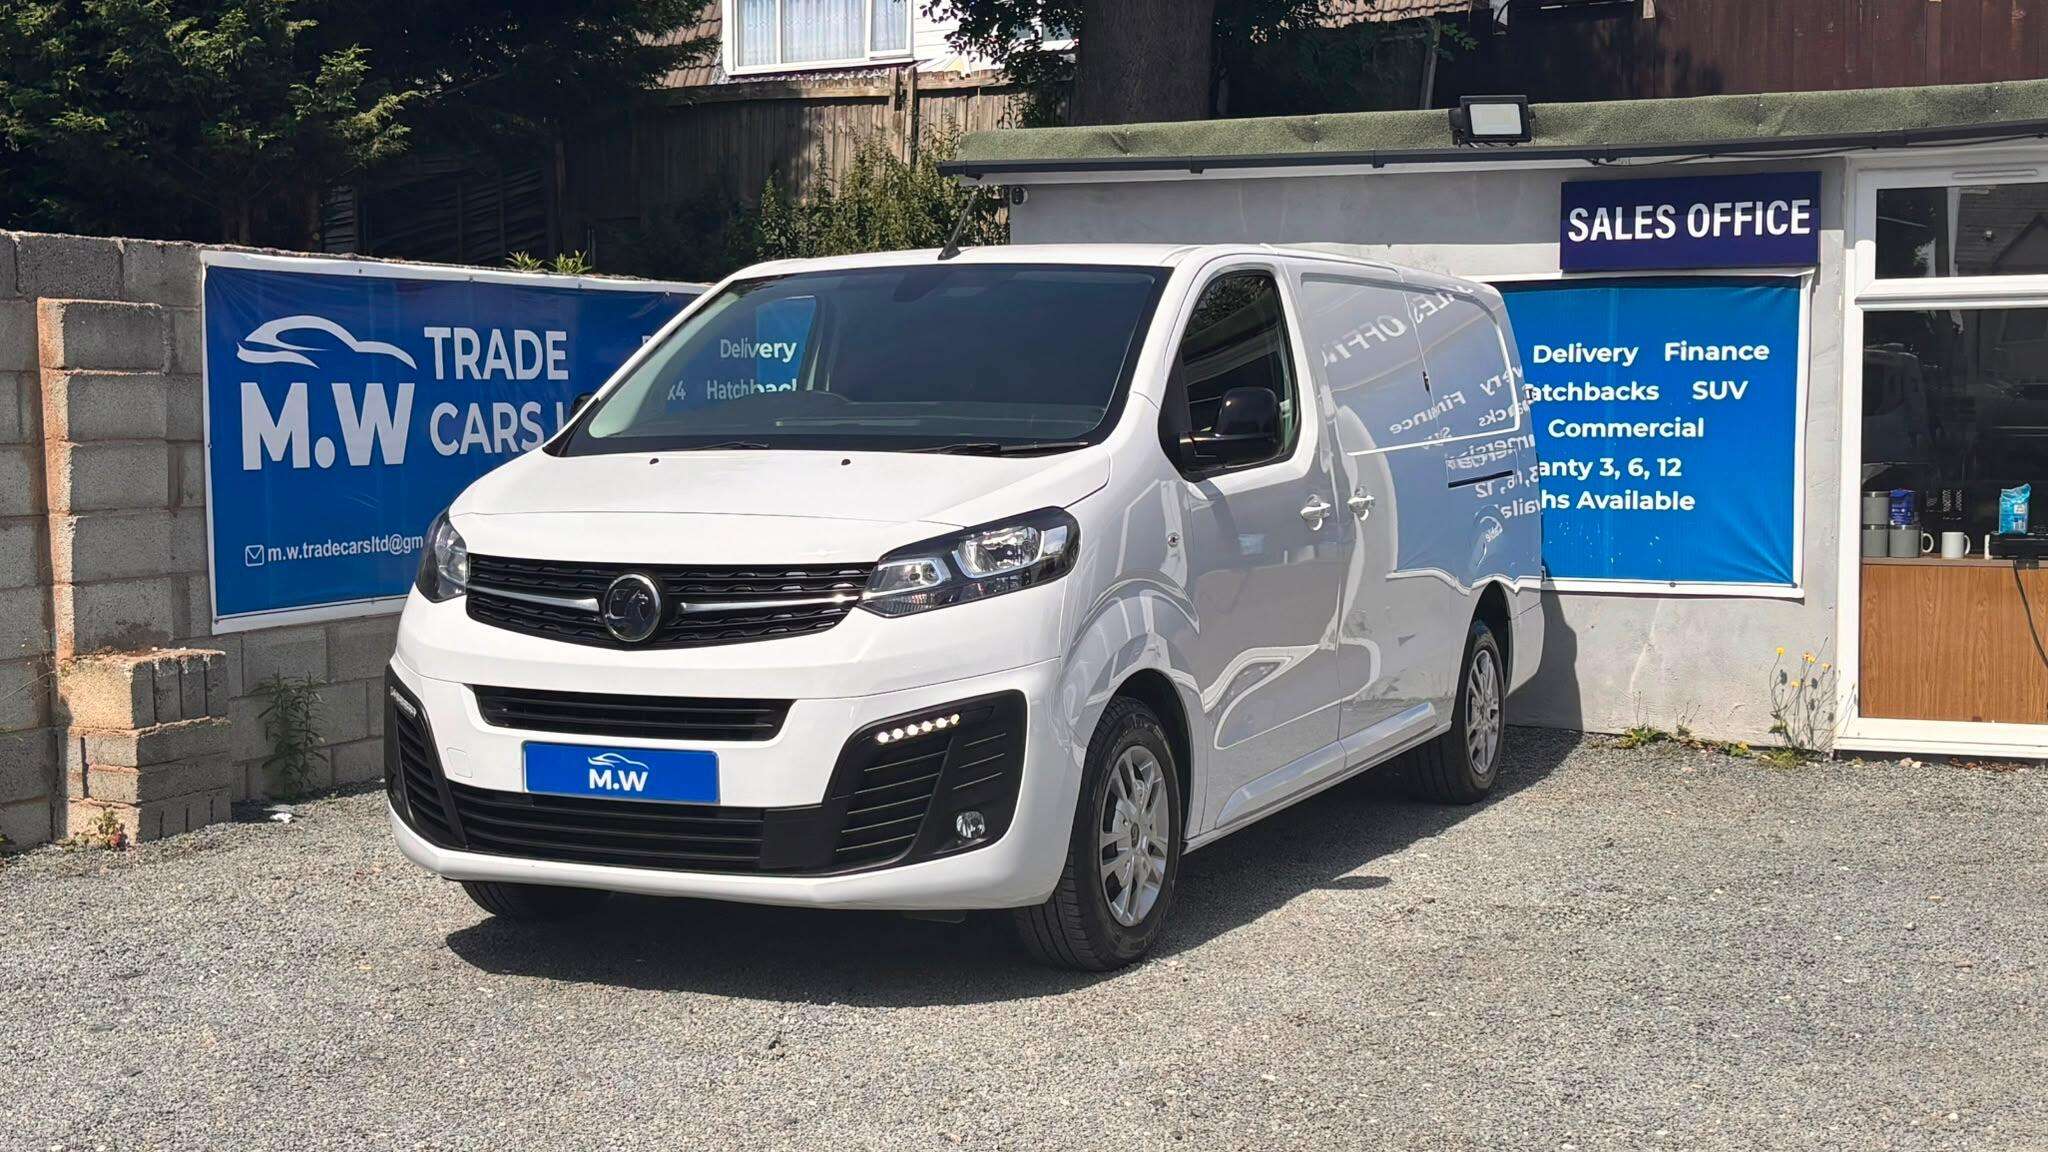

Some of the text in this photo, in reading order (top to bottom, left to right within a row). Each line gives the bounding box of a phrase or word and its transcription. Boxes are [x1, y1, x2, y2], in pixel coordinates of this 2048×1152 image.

[1567, 199, 1811, 242] SALES OFFICE
[424, 326, 569, 380] TRADE
[720, 337, 798, 363] Delivery
[1533, 340, 1770, 367] Delivery Finance
[1532, 380, 1749, 402] atchbacks SUV
[240, 382, 416, 471] M.W
[429, 401, 545, 456] CARS
[1548, 417, 1705, 439] Commercial
[1540, 457, 1683, 481] anty 3, 6, 12
[1541, 489, 1696, 511] hs Available
[267, 533, 424, 562] m.w.tradecarsltd@gm
[588, 768, 649, 792] M.W
